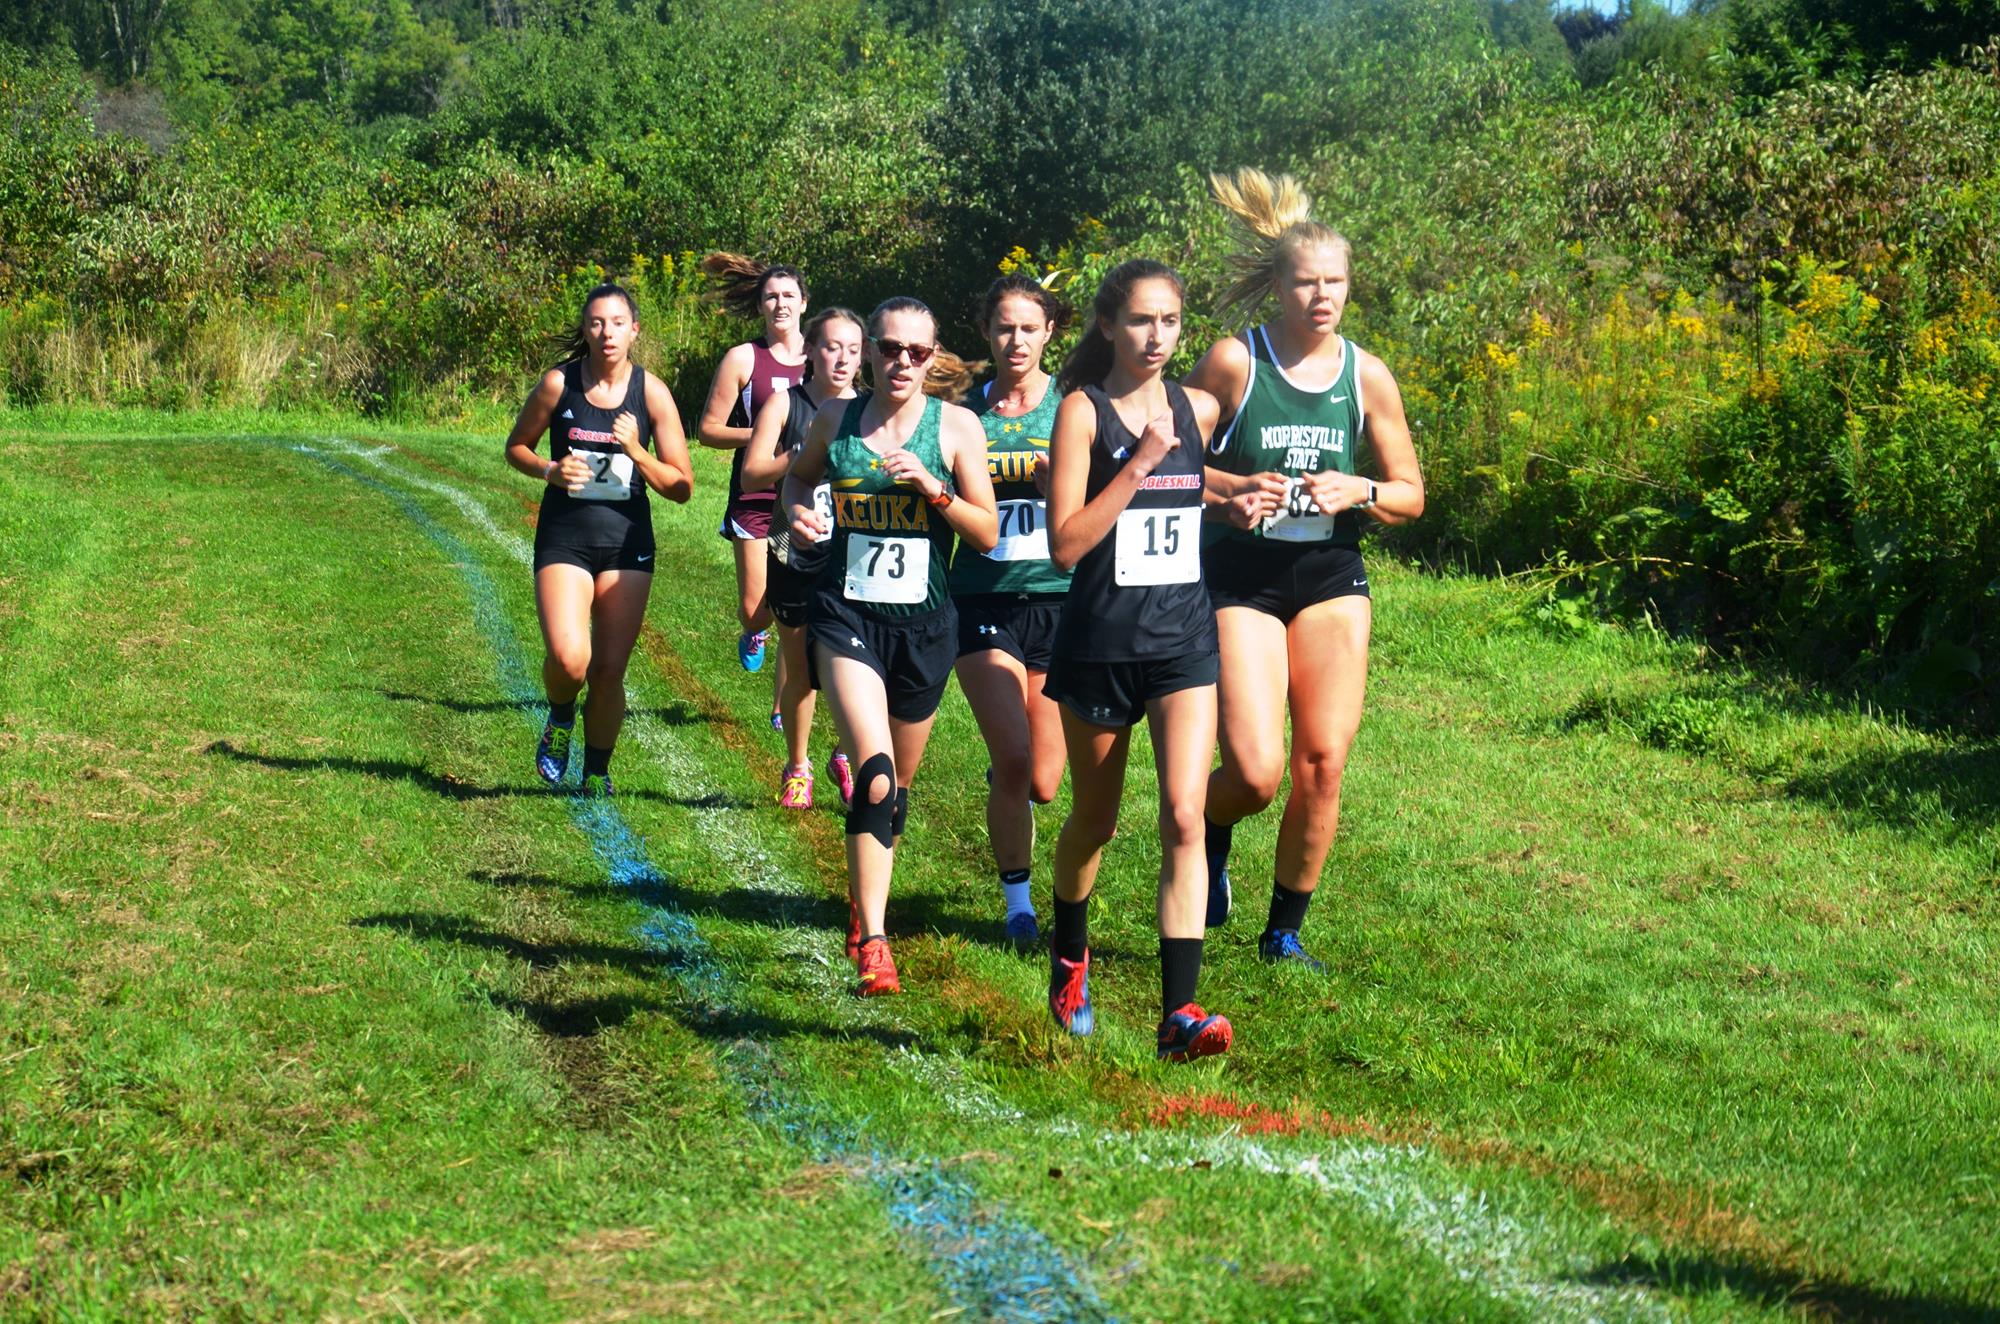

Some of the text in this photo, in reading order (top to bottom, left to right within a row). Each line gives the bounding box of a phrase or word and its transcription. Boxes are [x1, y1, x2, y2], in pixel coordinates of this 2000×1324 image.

[1260, 425, 1345, 453] MORRISVILLE
[594, 457, 611, 484] 2
[987, 450, 1046, 484] EUK
[1284, 447, 1320, 470] STATE
[1136, 474, 1201, 490] OBLESKILL
[832, 491, 930, 532] KEUKA
[998, 503, 1034, 537] 70
[1143, 515, 1181, 556] 15
[867, 541, 906, 580] 73
